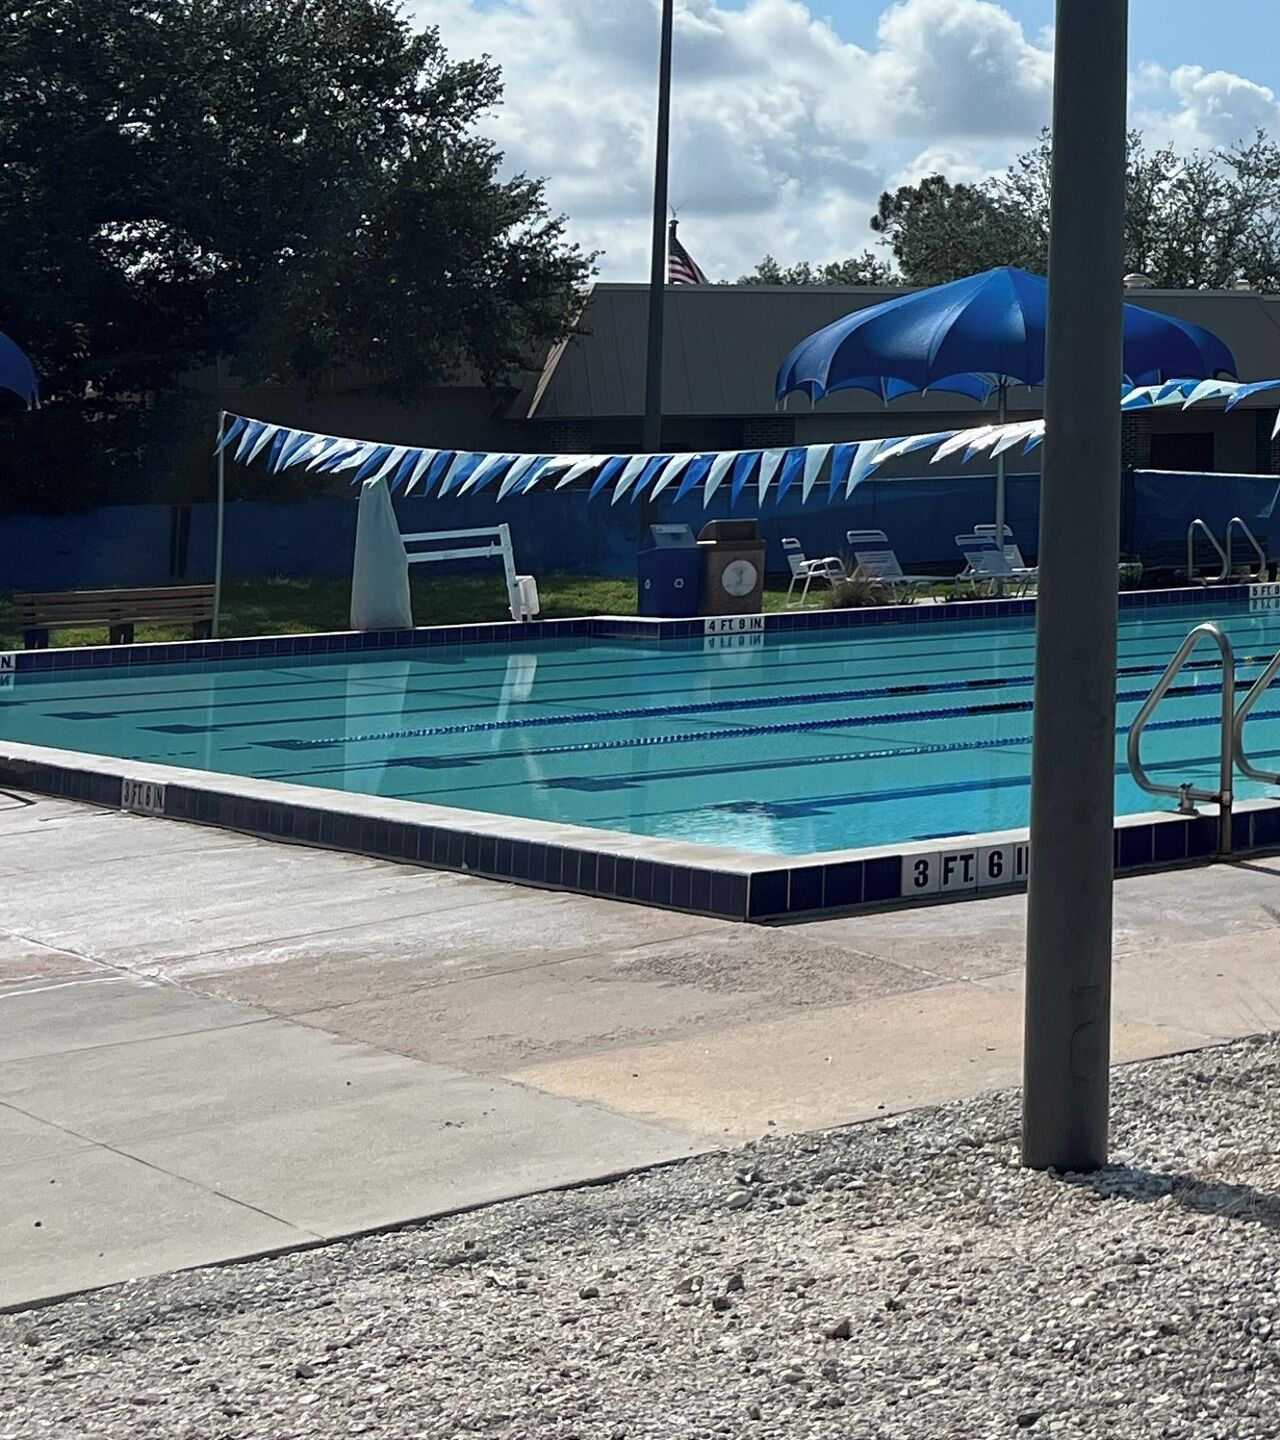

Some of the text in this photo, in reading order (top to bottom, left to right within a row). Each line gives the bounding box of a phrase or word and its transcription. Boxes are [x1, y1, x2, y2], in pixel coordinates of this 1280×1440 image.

[1252, 585, 1258, 596] 5
[708, 620, 716, 631] 4
[738, 618, 746, 630] 9
[124, 781, 130, 803] 3
[145, 785, 151, 807] 6
[913, 859, 930, 888] 3
[942, 853, 975, 886] FT.
[987, 850, 1003, 879] 6
